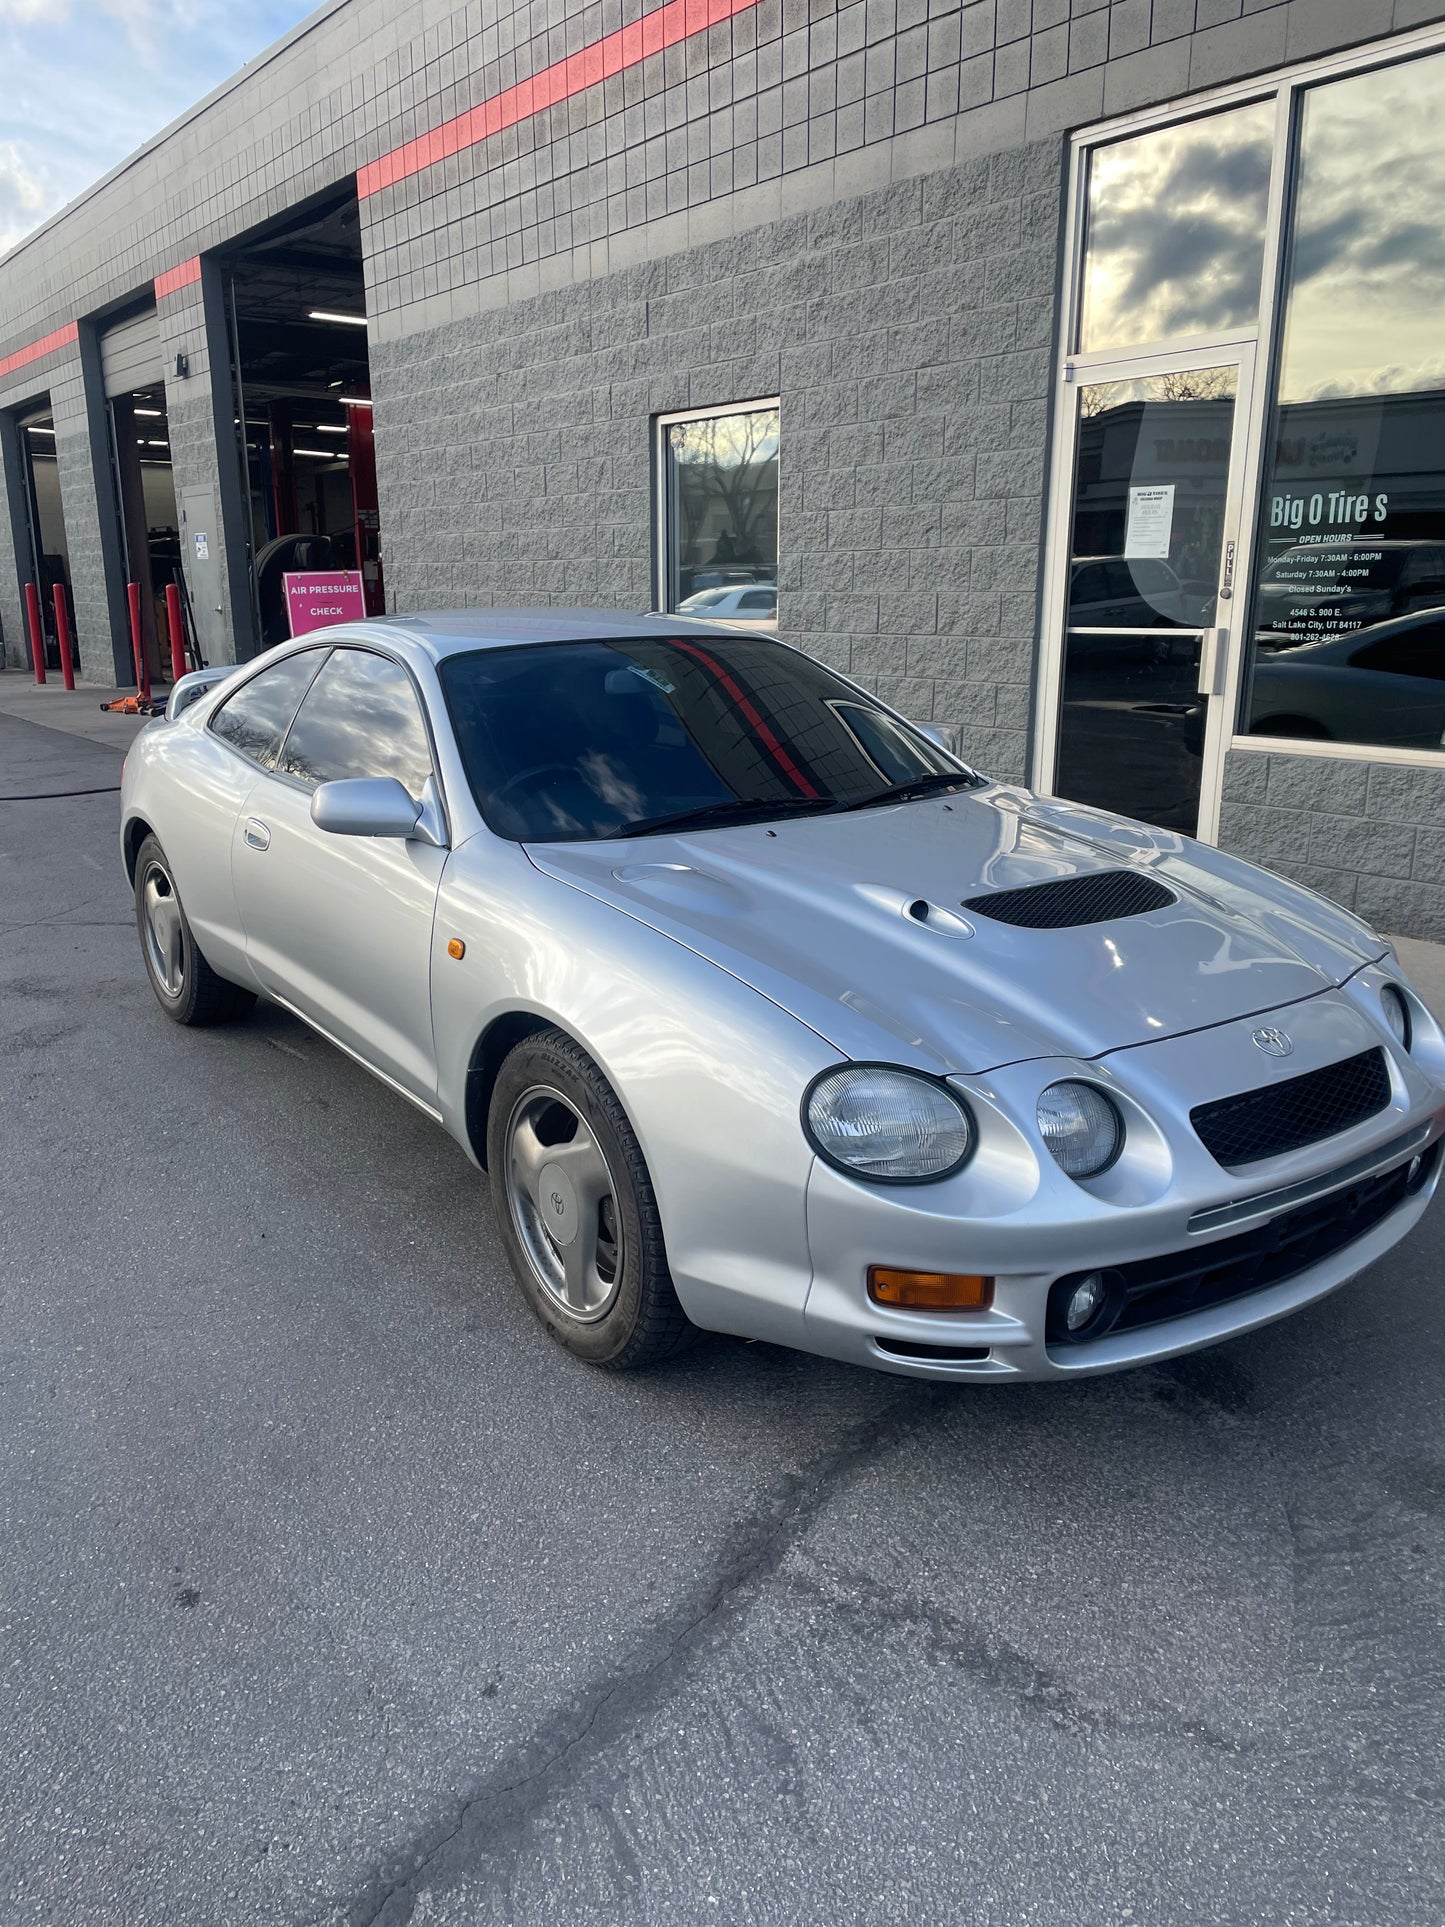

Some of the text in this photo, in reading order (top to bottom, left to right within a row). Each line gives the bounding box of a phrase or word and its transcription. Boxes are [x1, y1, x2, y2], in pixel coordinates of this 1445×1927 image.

[1270, 494, 1304, 529] Big
[1309, 493, 1323, 525] O
[1299, 533, 1352, 544] OPEN HOURS
[1226, 544, 1234, 575] PULL
[1267, 555, 1319, 565] Monday-Friday
[1320, 554, 1348, 562] 7:30AM
[1354, 552, 1382, 561] 6:00PM
[1275, 571, 1307, 579] Saturday
[1308, 569, 1336, 578] 7:30AM
[1341, 569, 1369, 577] 4:00PM
[309, 585, 359, 593] PRESSURE
[1288, 584, 1352, 594] Closed Sunday's
[310, 607, 343, 615] CHECK
[1290, 608, 1342, 616] 4546 S. 900 E.
[1272, 620, 1362, 630] Salt Lake City, UT 84117
[541, 1052, 579, 1083] BLIZZAK
